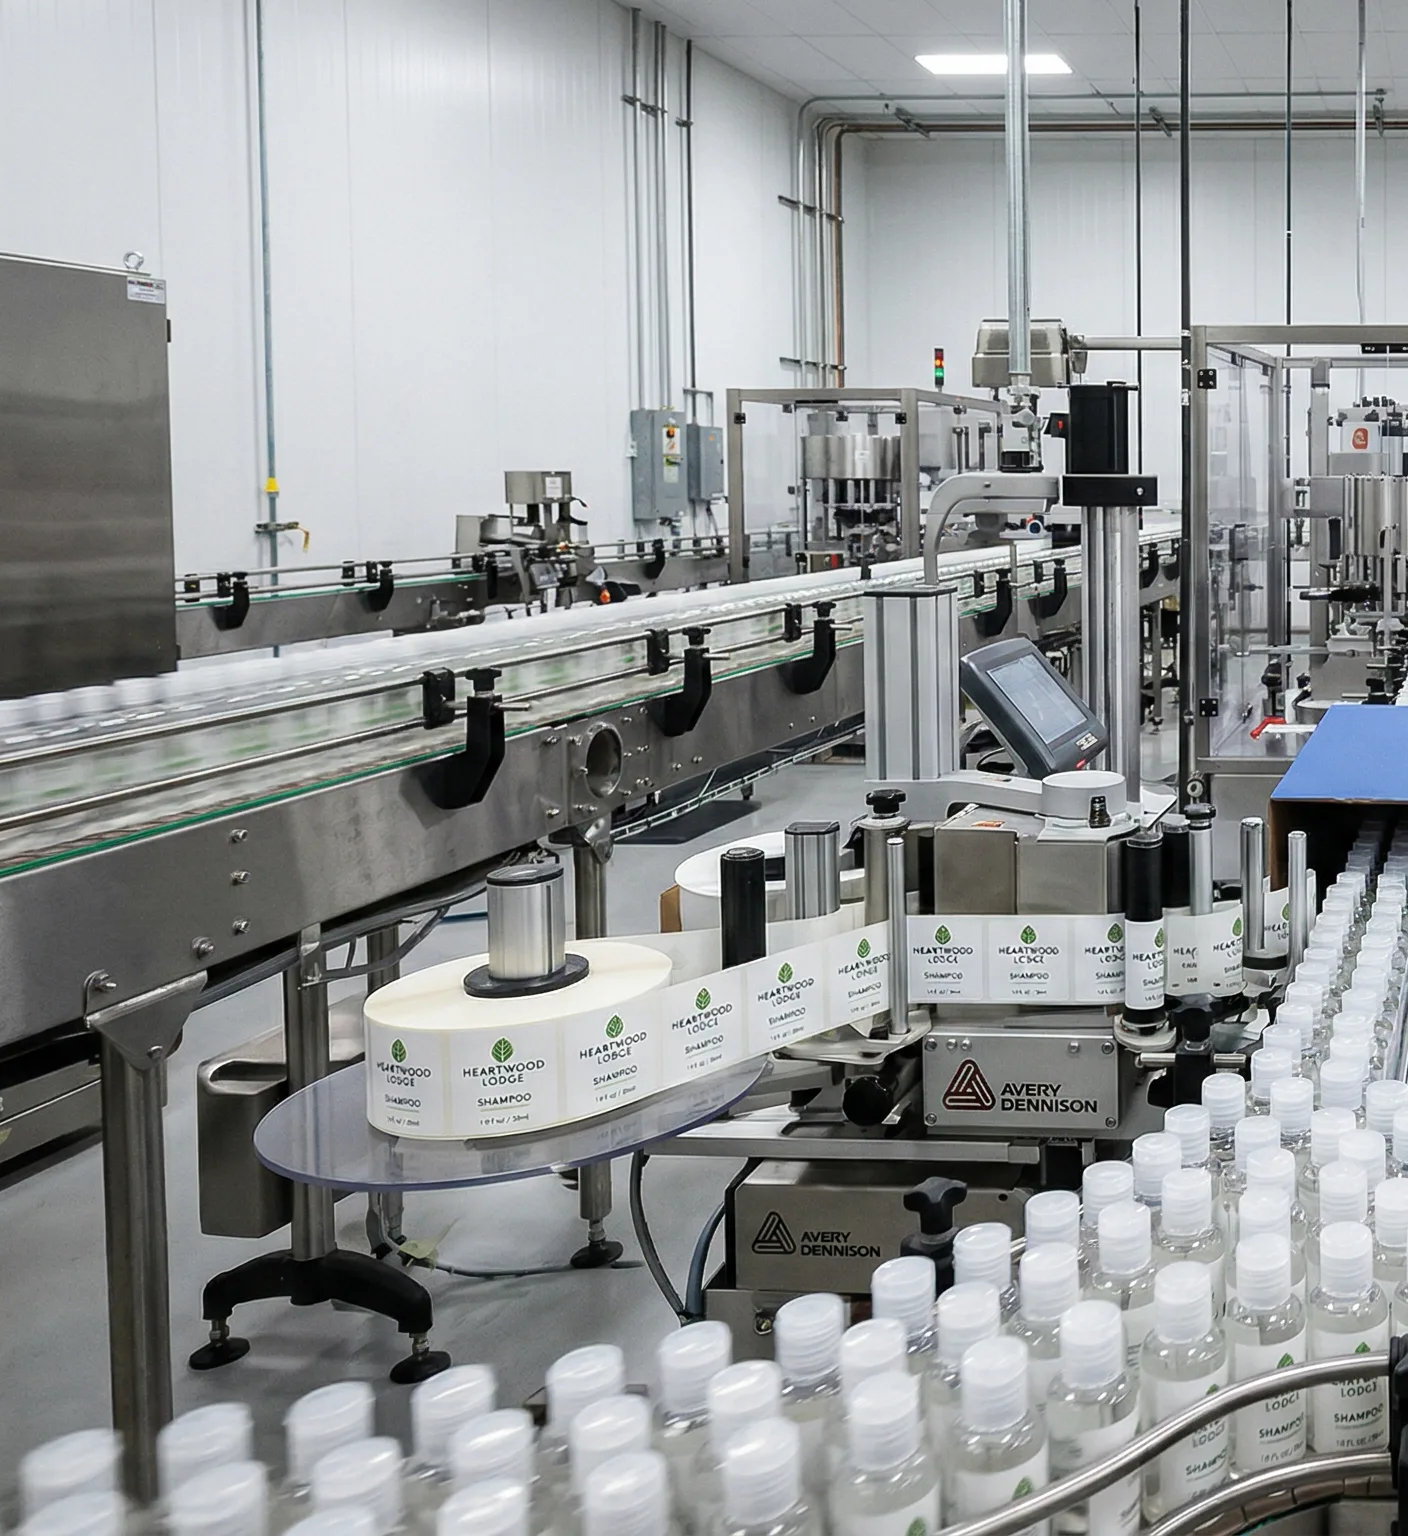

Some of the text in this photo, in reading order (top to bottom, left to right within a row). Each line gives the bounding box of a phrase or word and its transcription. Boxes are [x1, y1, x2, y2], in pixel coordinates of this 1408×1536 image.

[463, 1060, 545, 1077] HEARTWOOD
[482, 1074, 524, 1087] LODGE
[1000, 1083, 1062, 1097] AVERY
[477, 1093, 532, 1107] SHAMPOO
[1001, 1098, 1098, 1113] DENNISON
[801, 1231, 851, 1243] AVERY
[801, 1245, 881, 1258] DENNISON
[1334, 1403, 1384, 1423] SHAMPOO
